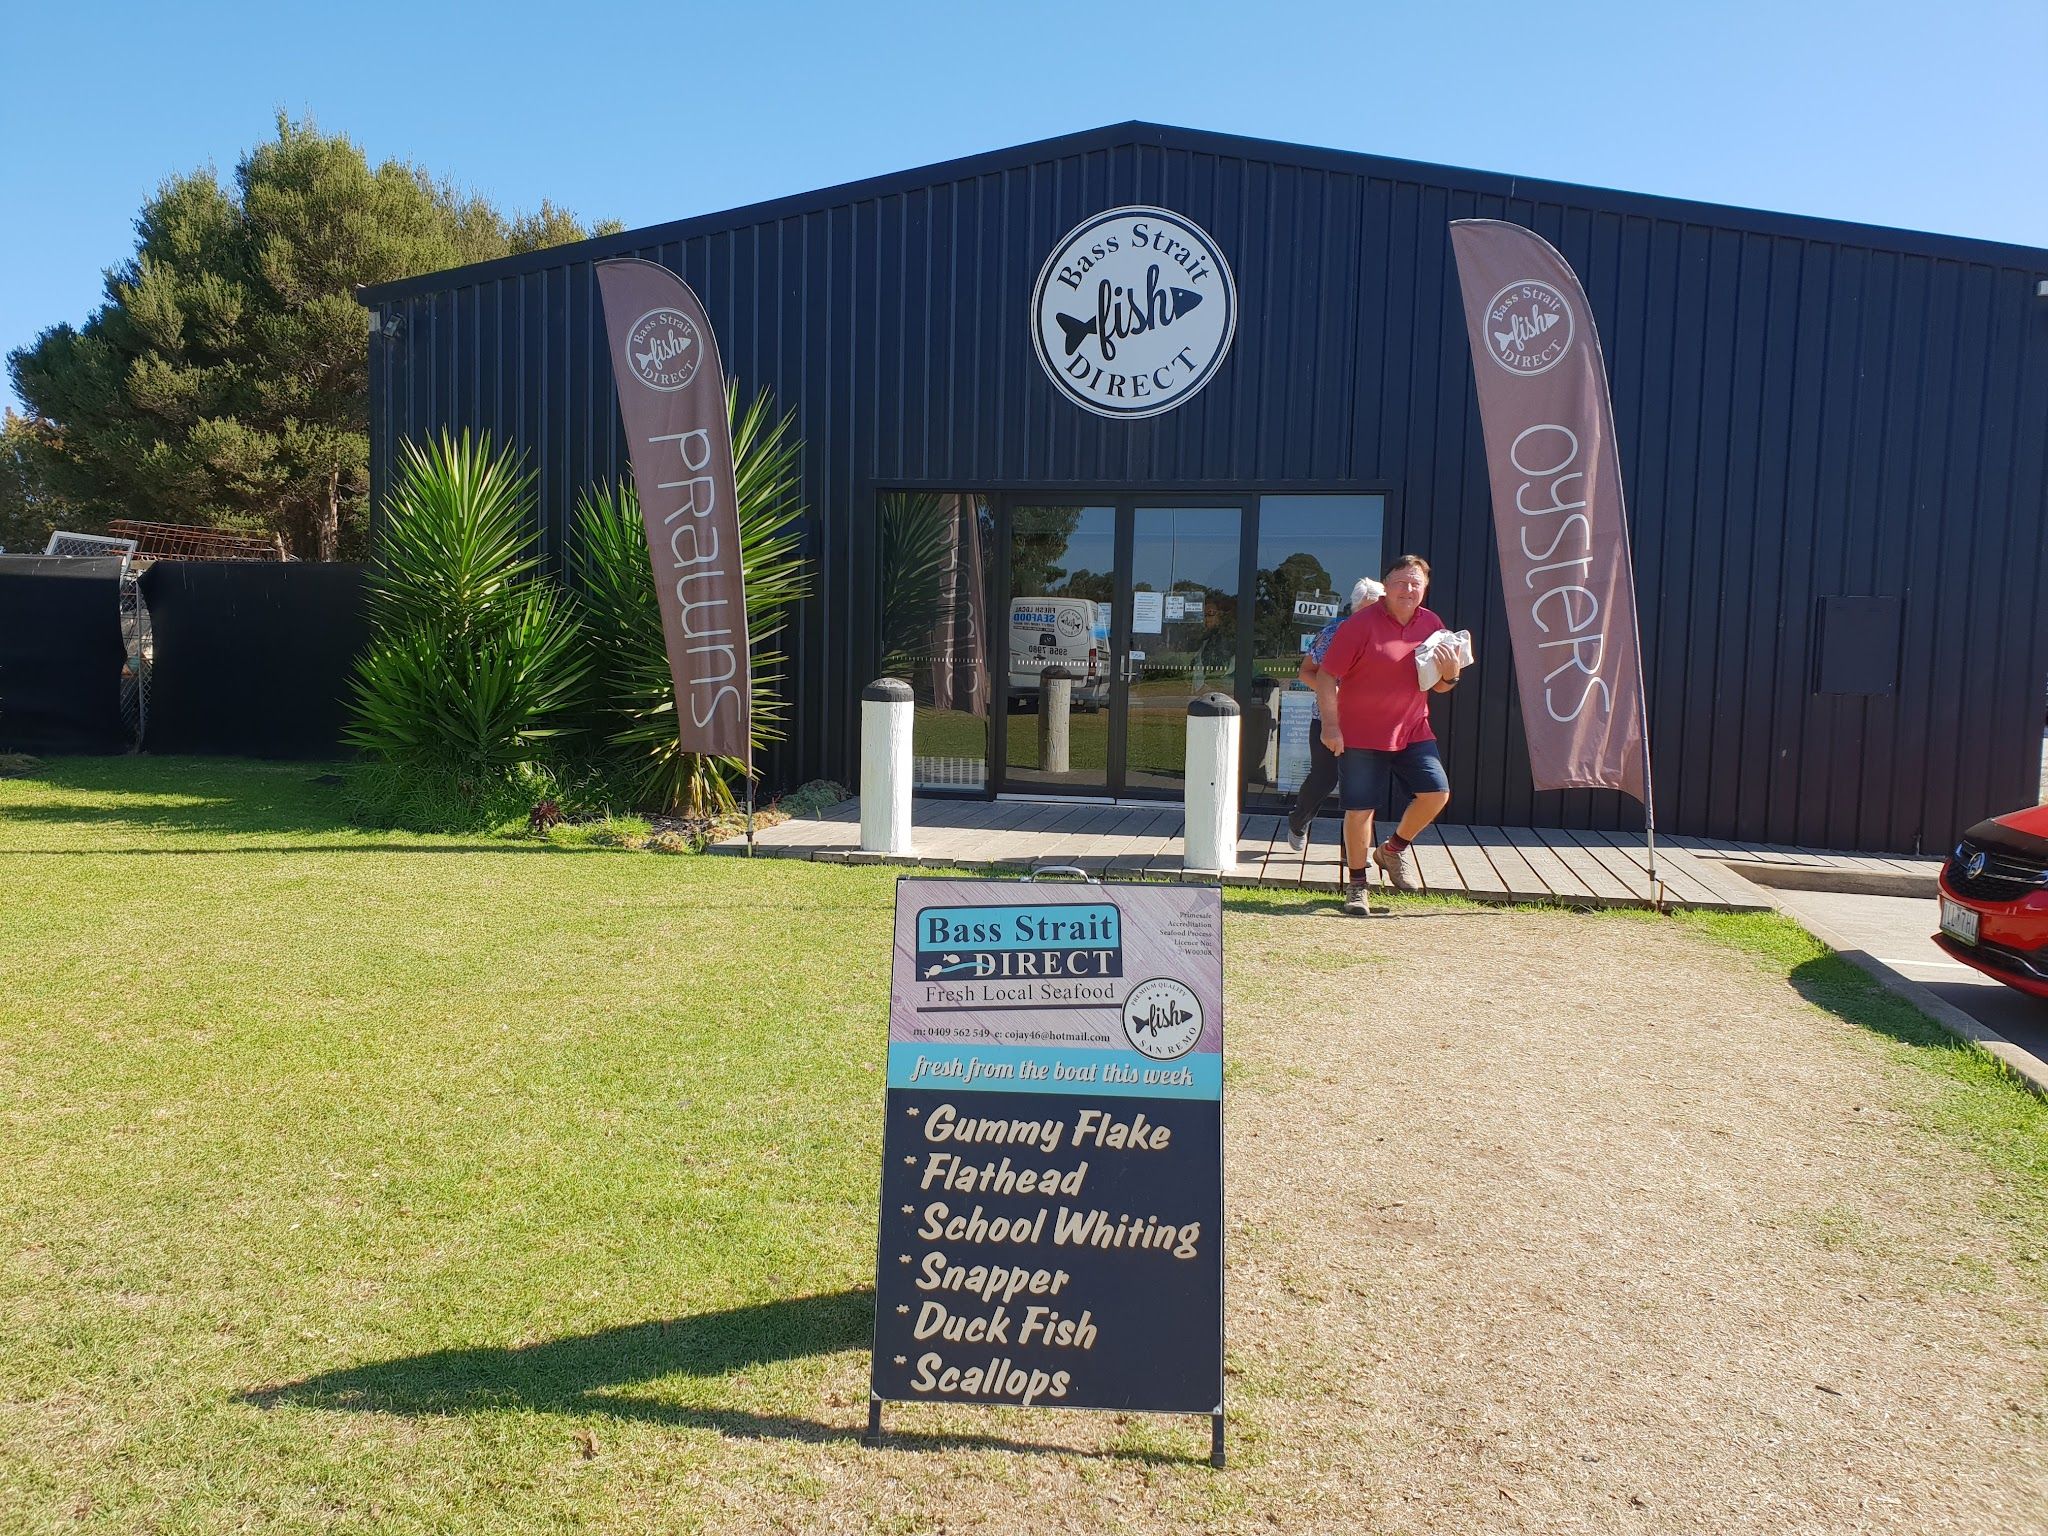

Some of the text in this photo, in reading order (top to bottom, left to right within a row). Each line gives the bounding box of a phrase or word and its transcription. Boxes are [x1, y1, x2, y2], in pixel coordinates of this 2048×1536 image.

[1056, 223, 1210, 292] Bass Strait
[1099, 264, 1175, 361] fish
[1491, 286, 1562, 322] Bass Strait
[633, 313, 693, 345] Bass Strait
[1511, 303, 1549, 352] fish
[650, 328, 684, 371] fish
[1501, 338, 1562, 368] DIRECT
[641, 359, 695, 385] DIRECT
[1064, 346, 1199, 398] DIRECT
[1298, 602, 1334, 617] OPEN
[927, 913, 1113, 944] Bass Strait
[1167, 920, 1212, 928] Accreditation
[973, 950, 1114, 978] DIRECT
[925, 982, 1115, 1002] Fresh Local Seafood
[1130, 982, 1188, 1006] PREMIUM QUALITY
[913, 1028, 926, 1036] m:
[927, 1027, 951, 1037] 0409
[953, 1028, 971, 1037] 562
[972, 1029, 990, 1038] 549
[1004, 1030, 1111, 1042] cojay46@hotmail.com
[1149, 999, 1181, 1038] fish
[1167, 1027, 1197, 1054] REMO
[910, 1055, 1195, 1086] fresh from the boat this week
[924, 1103, 1172, 1153] Gummy Flake
[920, 1152, 1089, 1196] Flathead
[917, 1201, 1201, 1260] School Whiting
[915, 1251, 1070, 1304] Snapper
[913, 1300, 1098, 1350] Duck Fish
[910, 1351, 1071, 1406] Scallops
